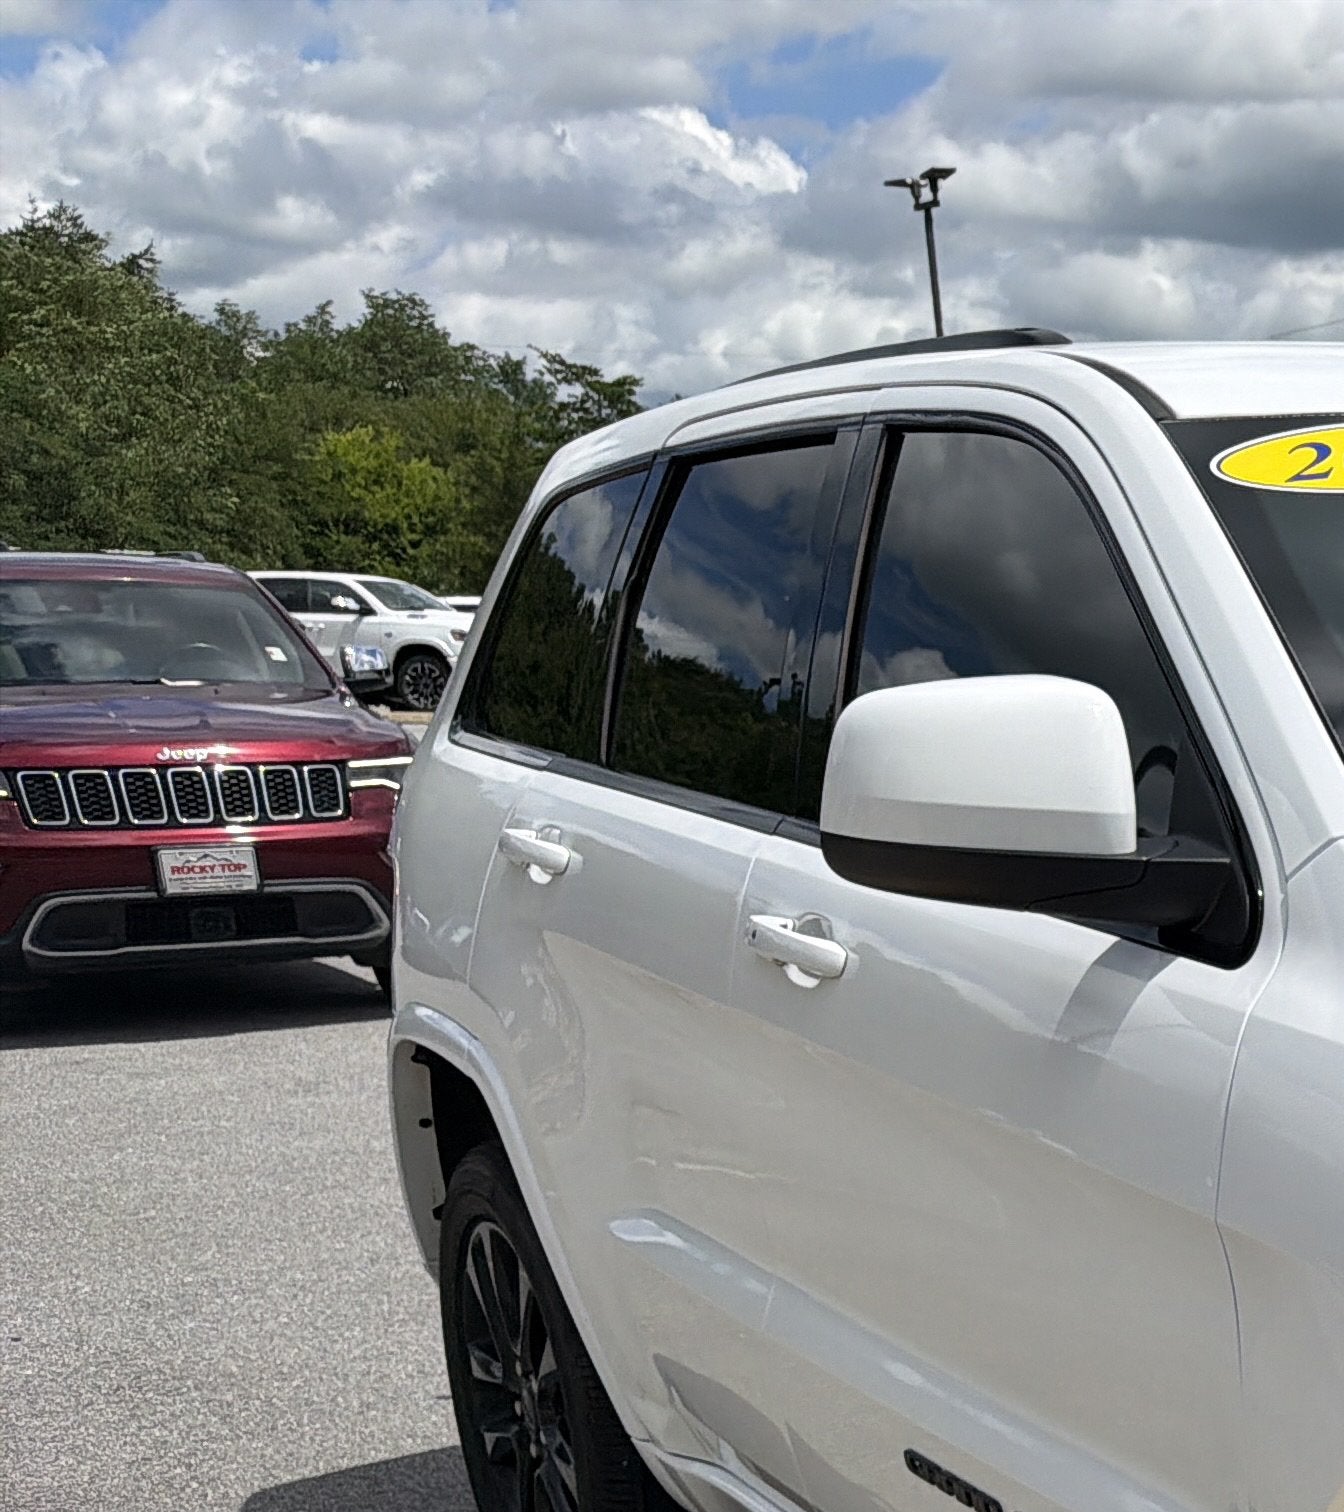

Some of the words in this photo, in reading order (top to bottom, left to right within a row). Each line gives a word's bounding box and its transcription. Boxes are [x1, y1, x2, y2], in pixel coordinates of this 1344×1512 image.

[157, 747, 209, 762] Jeep
[170, 864, 216, 875] ROCKY
[218, 863, 248, 873] TOP
